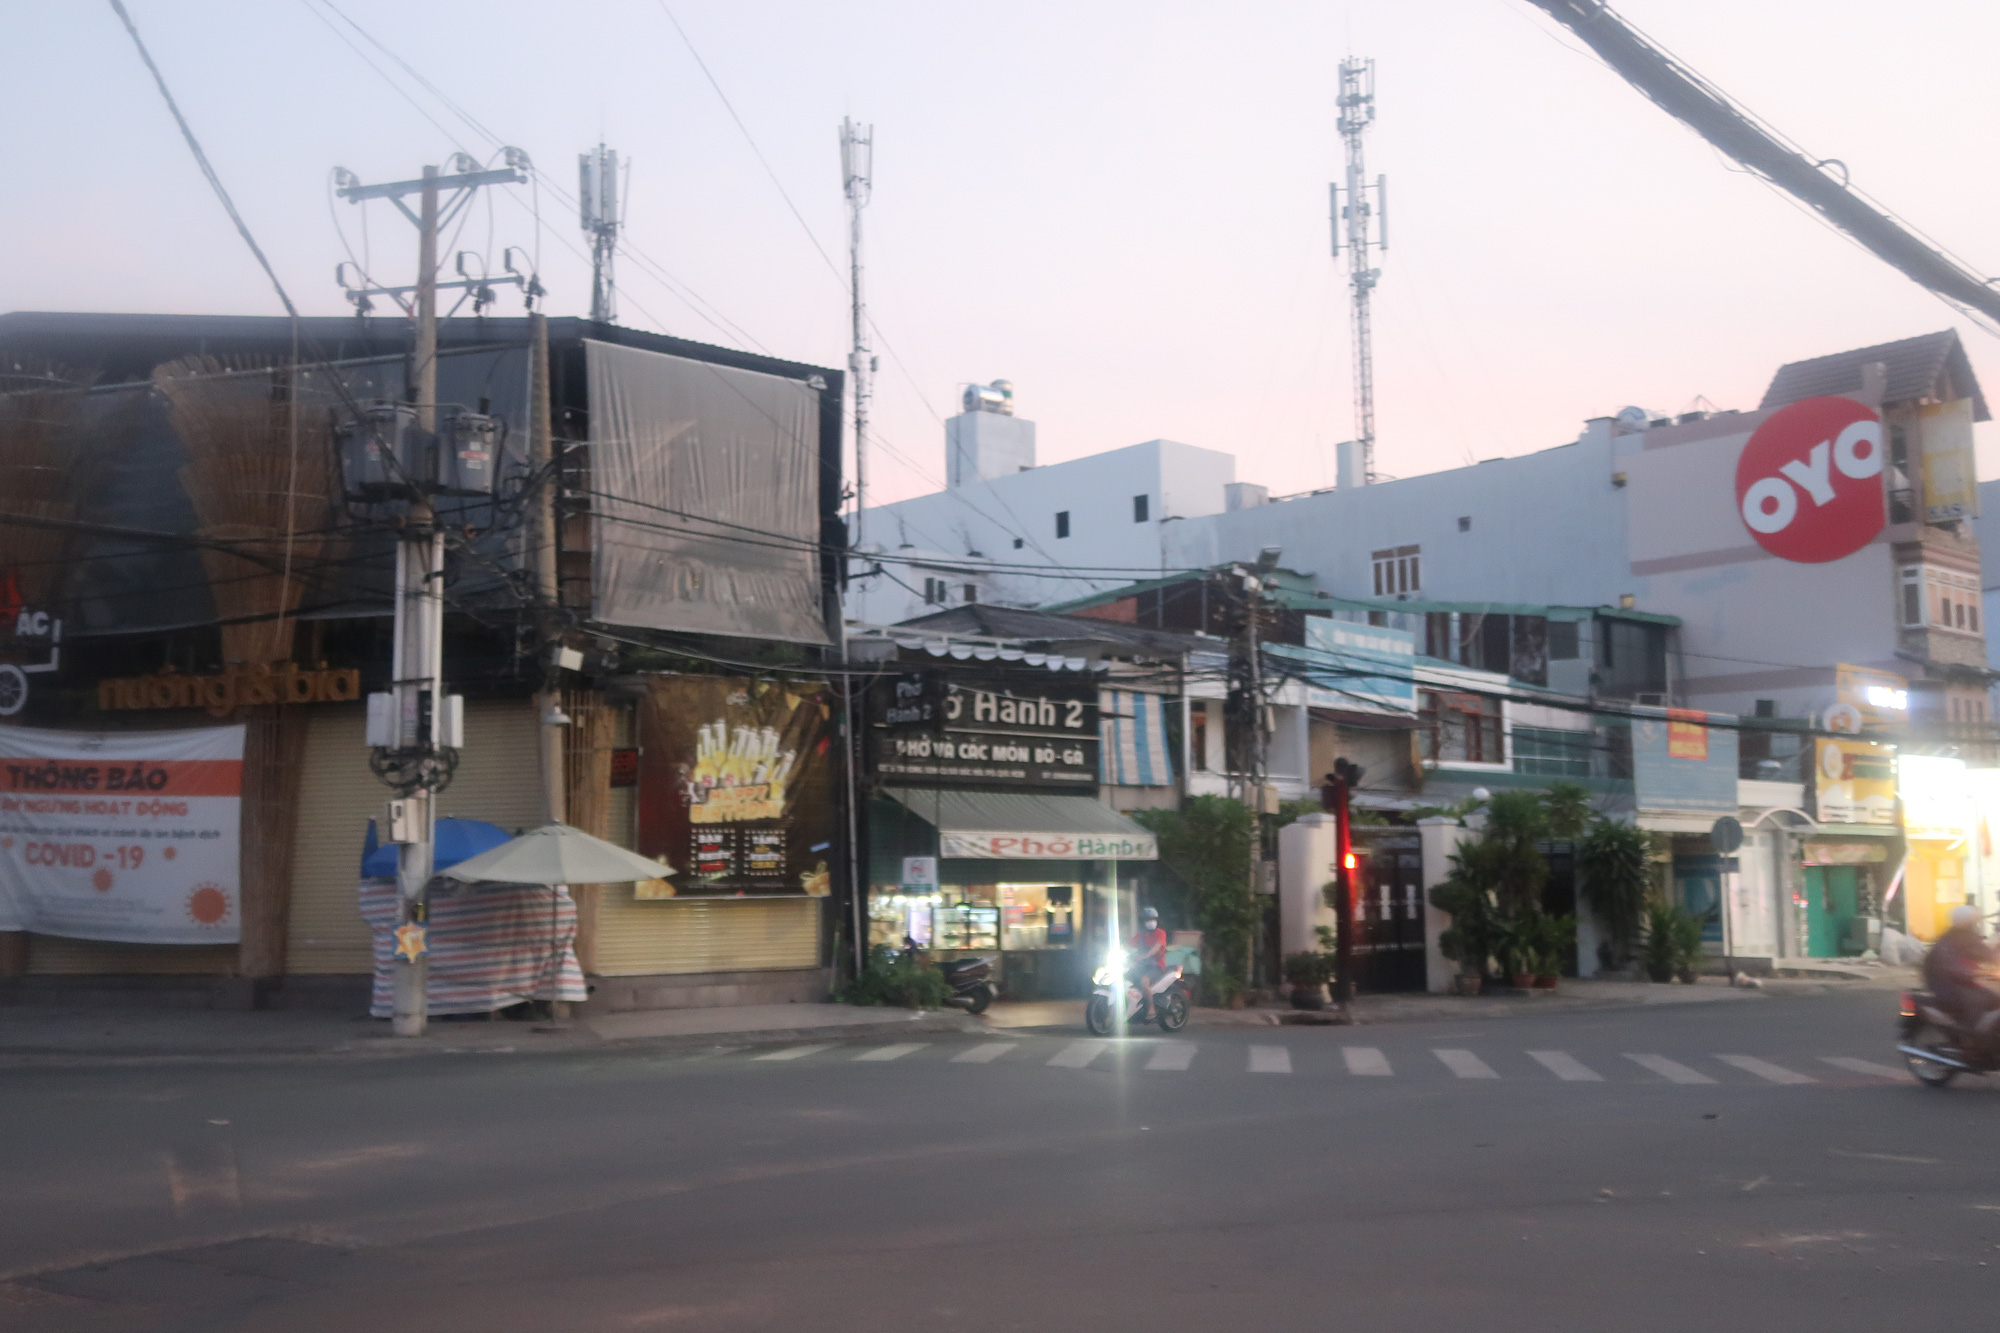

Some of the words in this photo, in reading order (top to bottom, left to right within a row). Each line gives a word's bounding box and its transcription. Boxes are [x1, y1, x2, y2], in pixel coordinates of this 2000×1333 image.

[1743, 420, 1883, 533] OYO
[922, 704, 932, 721] 2
[974, 689, 1057, 727] Hành
[1064, 699, 1085, 729] 2
[958, 737, 989, 761] CÁC
[992, 740, 1030, 763] MÓN
[6, 760, 99, 790] THÔNG
[105, 761, 168, 791] BÁO
[24, 841, 96, 867] COVID
[990, 836, 1074, 856] Phở
[1077, 838, 1134, 855] Hành
